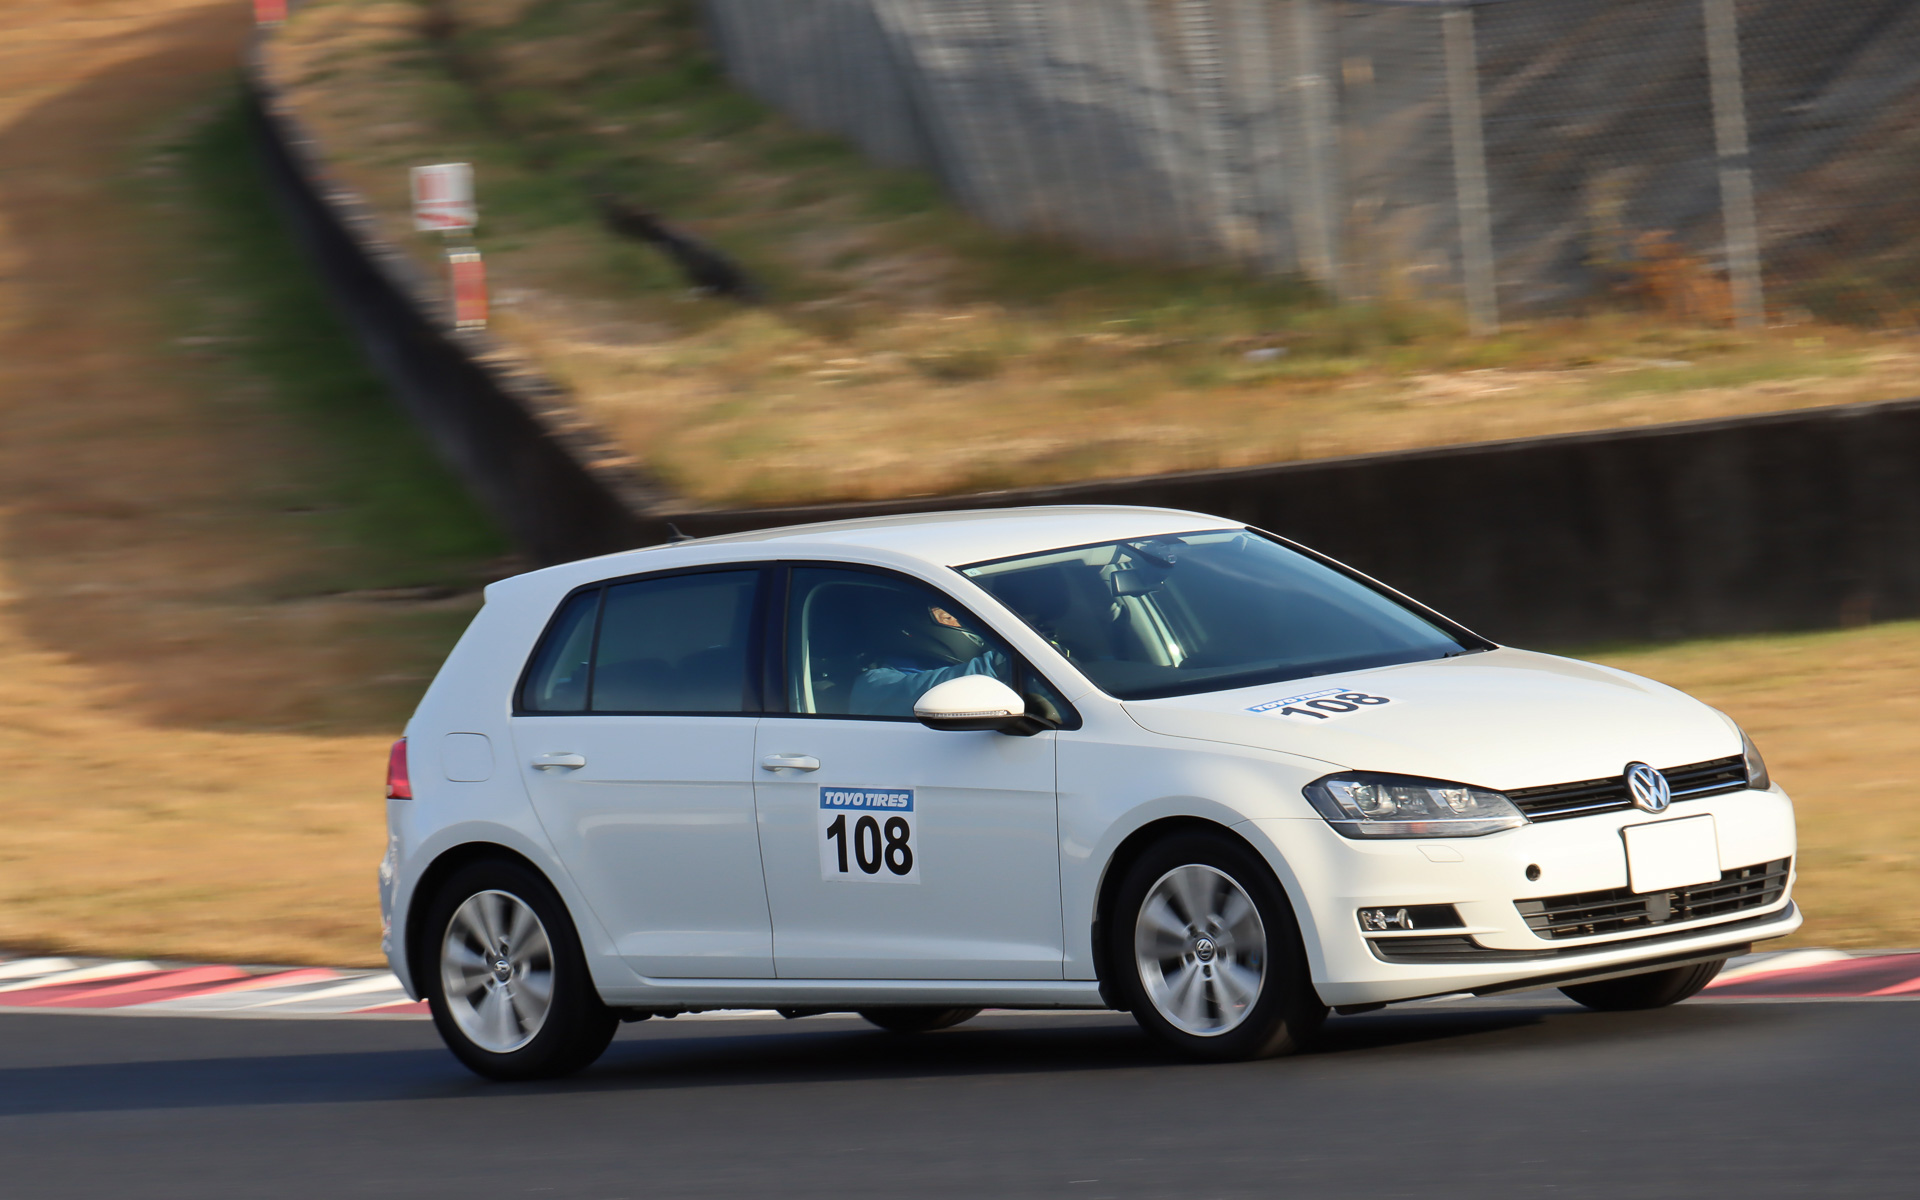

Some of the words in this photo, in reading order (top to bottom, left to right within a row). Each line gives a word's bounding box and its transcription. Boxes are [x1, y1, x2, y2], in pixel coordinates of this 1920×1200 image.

[1252, 698, 1298, 711] TOYO
[1280, 692, 1390, 720] 108
[825, 791, 864, 806] TOYO
[865, 793, 909, 808] TIRES
[826, 814, 914, 876] 108
